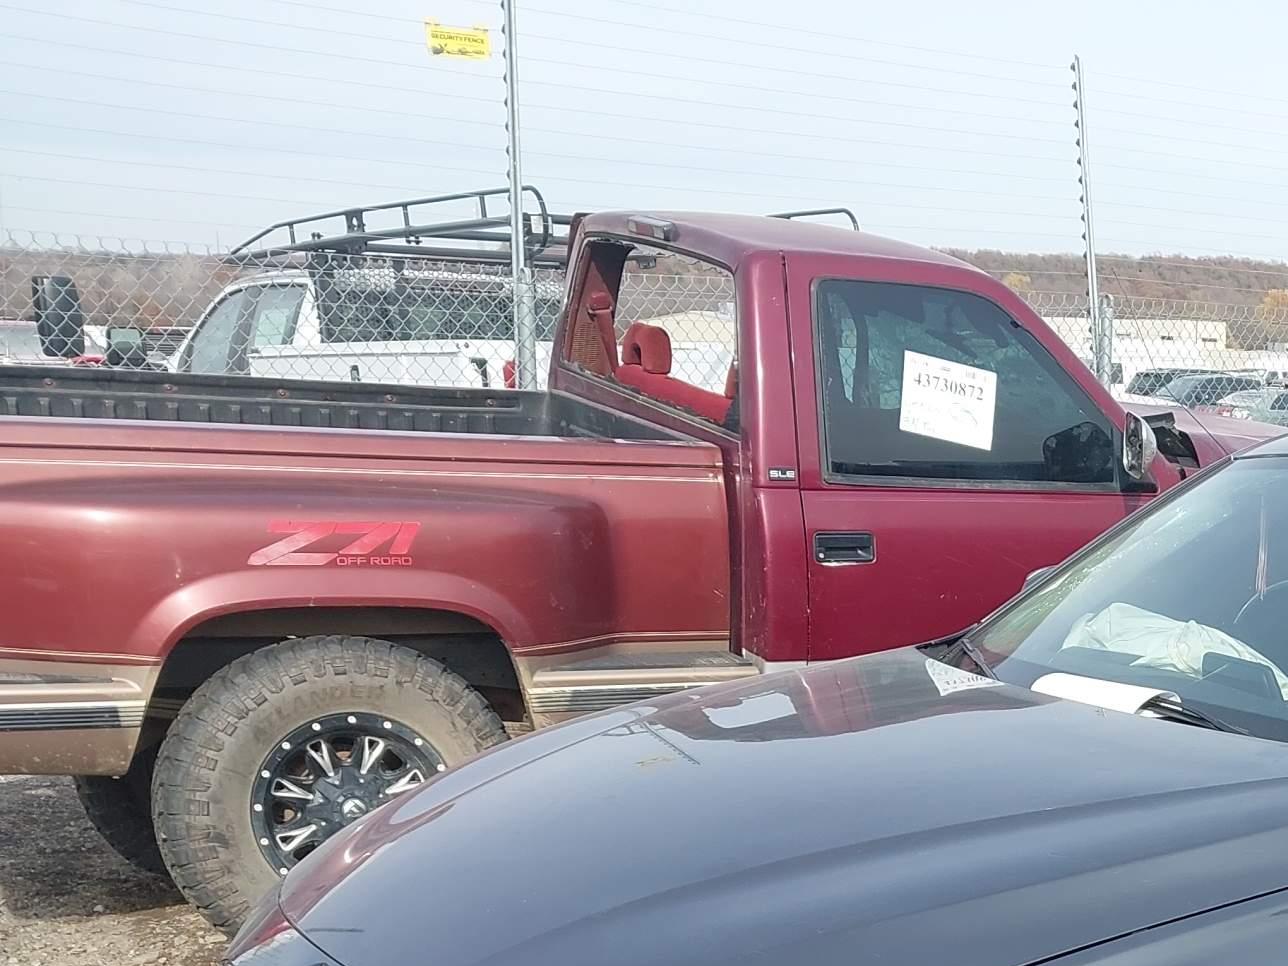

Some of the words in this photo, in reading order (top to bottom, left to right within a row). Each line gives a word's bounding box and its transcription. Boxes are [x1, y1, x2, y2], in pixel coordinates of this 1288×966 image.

[431, 33, 463, 41] SECURITY
[913, 372, 984, 401] 43730872
[769, 469, 795, 478] SLE
[248, 520, 422, 566] Z71
[336, 556, 369, 566] OFF
[370, 556, 413, 566] ROAD
